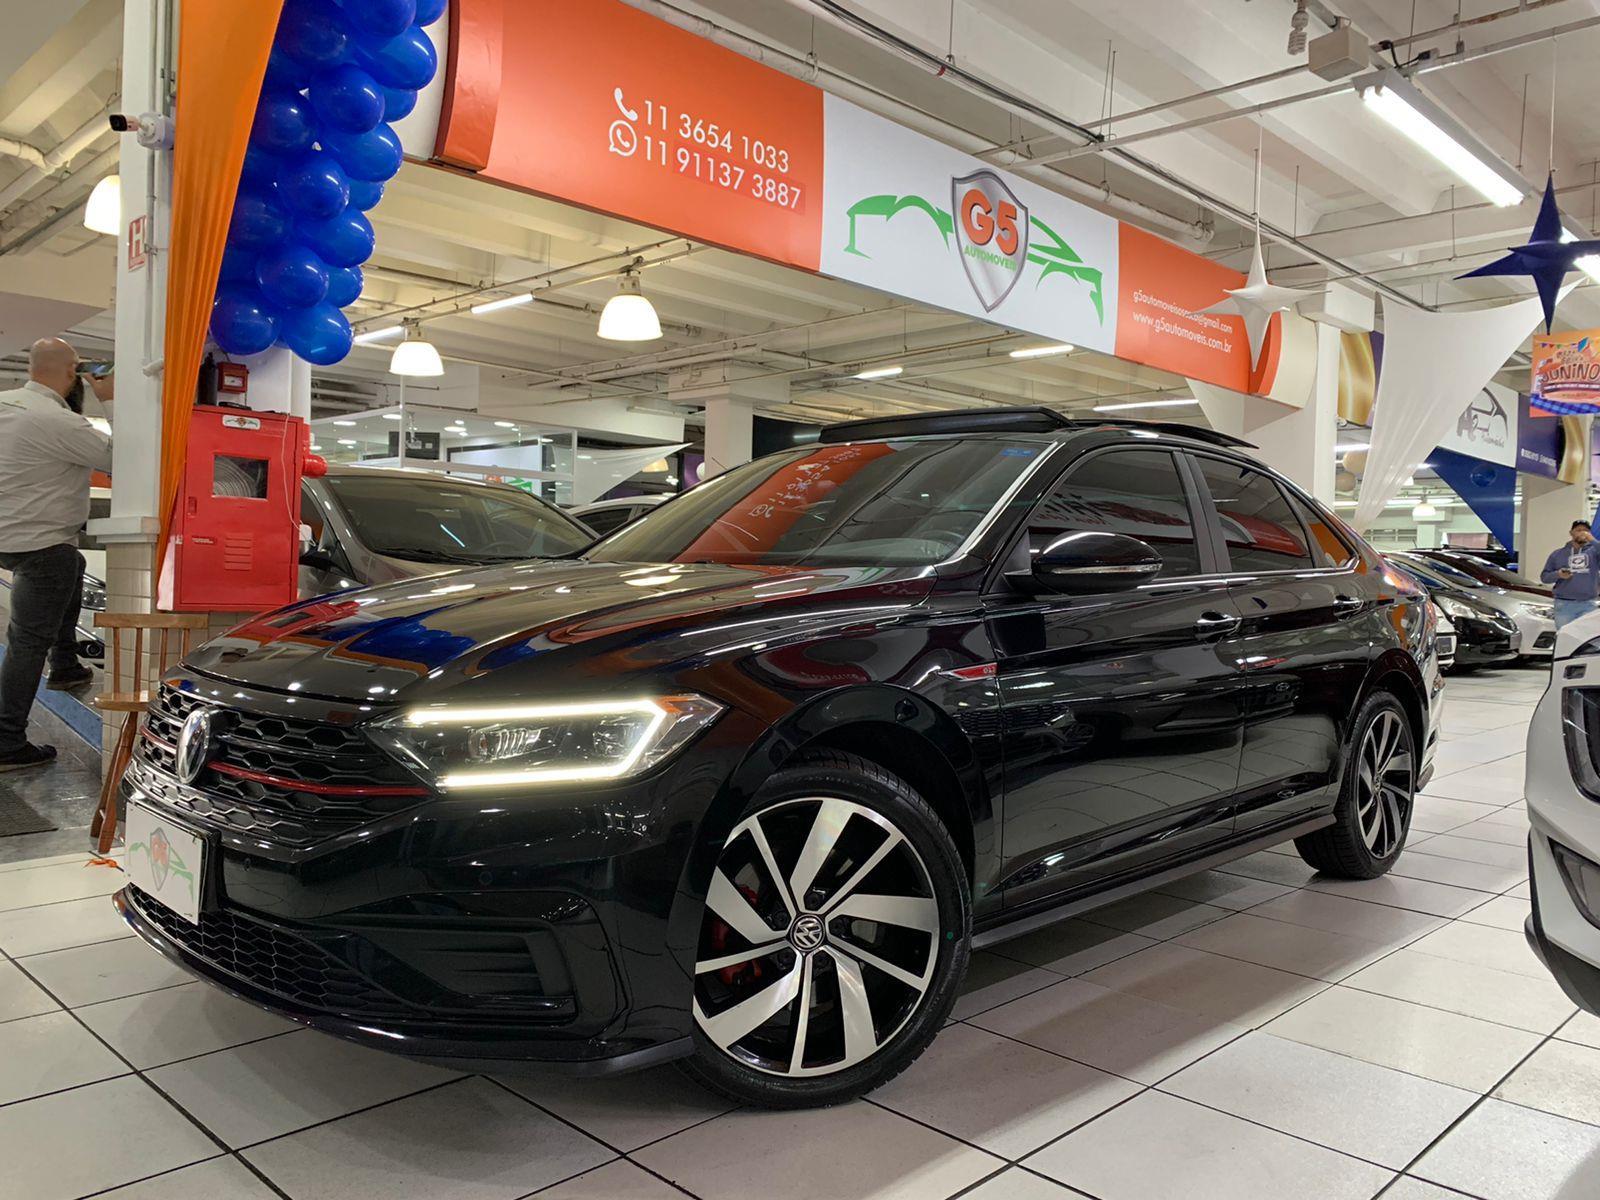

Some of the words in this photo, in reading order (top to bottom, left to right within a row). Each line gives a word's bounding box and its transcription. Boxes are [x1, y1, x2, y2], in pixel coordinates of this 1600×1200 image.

[645, 100, 667, 130] 11
[679, 113, 733, 153] 3654
[742, 136, 789, 173] 1033
[644, 136, 666, 165] 11
[677, 147, 744, 190] 91137
[752, 174, 801, 209] 3887
[961, 188, 1018, 256] G5
[1132, 311, 1233, 353] www.g5automoveis.com.br
